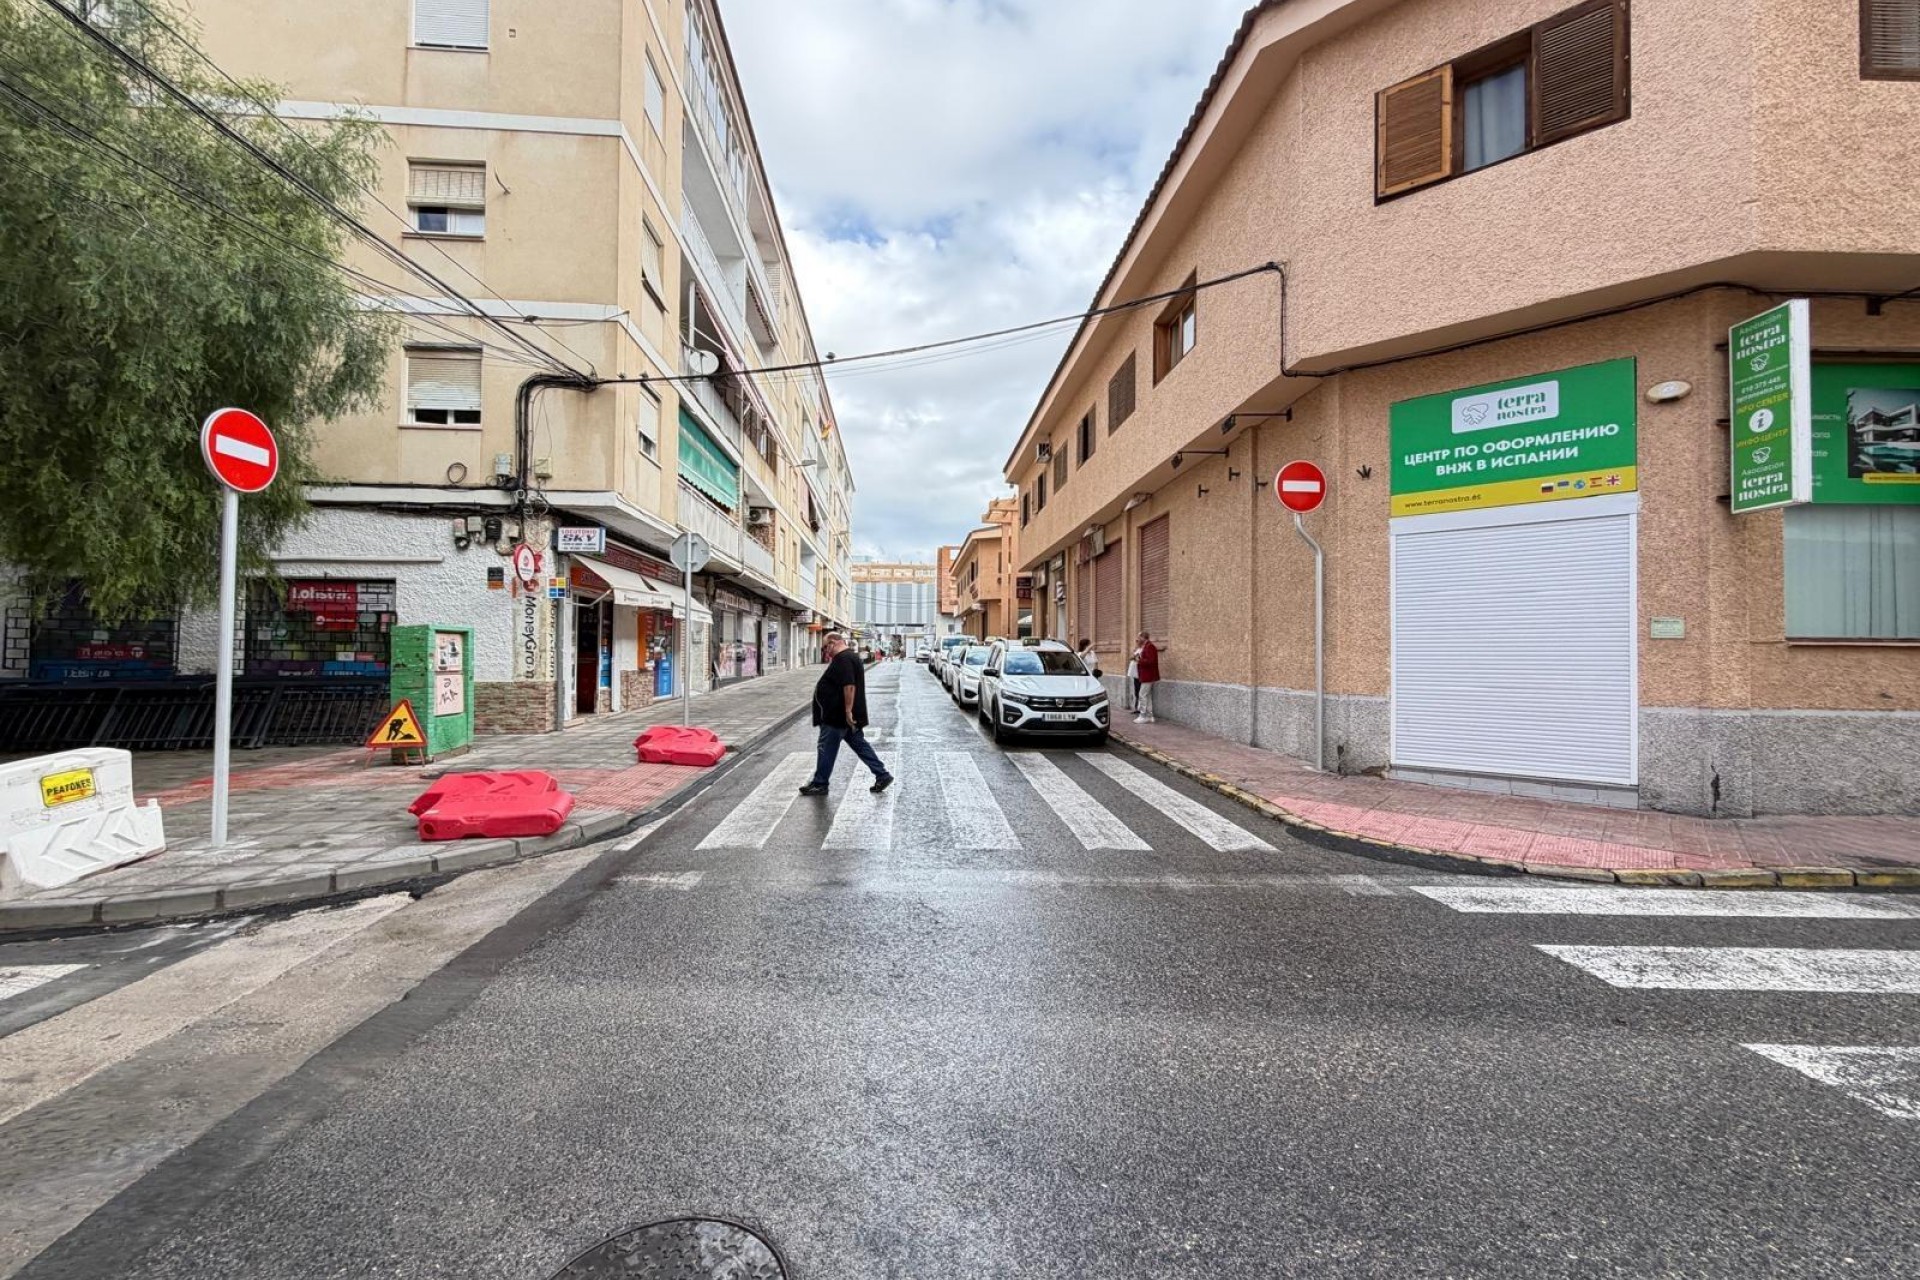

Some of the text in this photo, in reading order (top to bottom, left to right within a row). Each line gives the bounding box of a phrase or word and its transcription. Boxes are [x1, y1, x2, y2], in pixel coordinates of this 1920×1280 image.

[1740, 324, 1781, 347] terra
[1736, 334, 1786, 360] nostra
[1498, 392, 1545, 410] terra
[1756, 392, 1789, 408] CENTER
[1497, 405, 1546, 420] nostra
[1404, 423, 1619, 466] ЦЕНТР ПО ОФОРМЛЕНИЮ
[1436, 446, 1579, 477] ВНЖ В ИСПАНИИ
[1742, 472, 1783, 489] terra
[1404, 493, 1482, 509] www.terranostra.es
[1739, 483, 1788, 501] nostra
[562, 534, 595, 542] SKY
